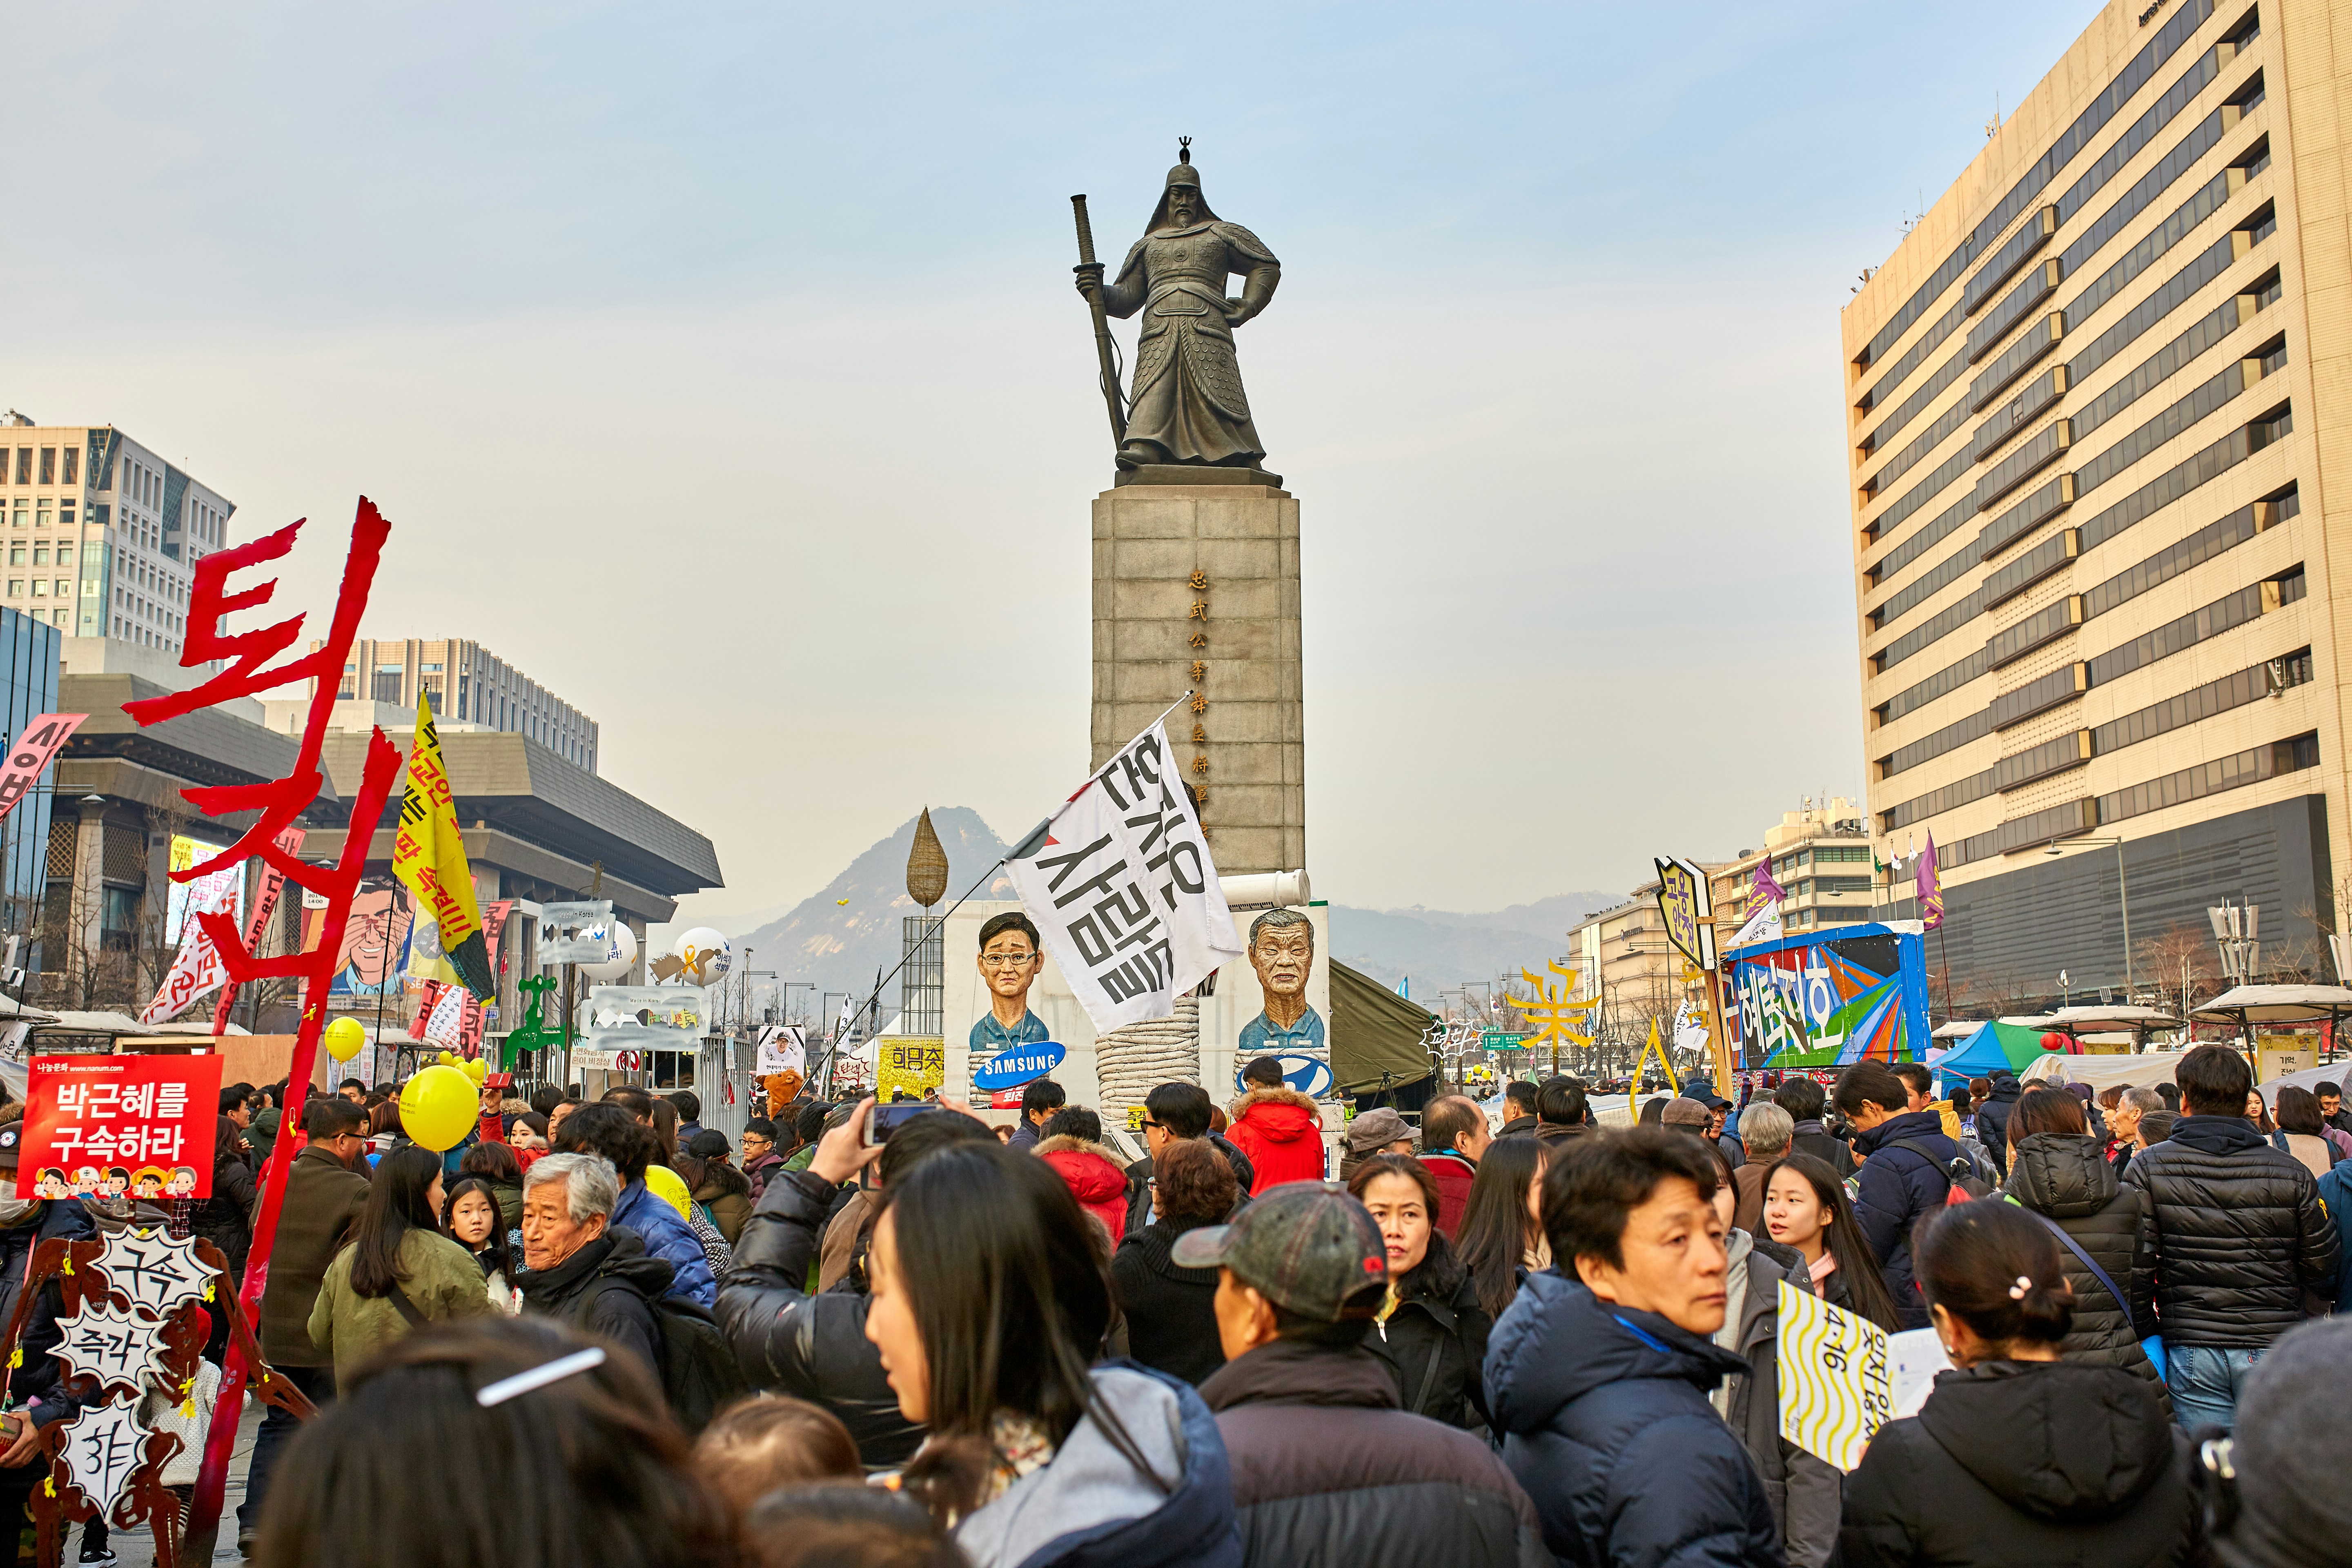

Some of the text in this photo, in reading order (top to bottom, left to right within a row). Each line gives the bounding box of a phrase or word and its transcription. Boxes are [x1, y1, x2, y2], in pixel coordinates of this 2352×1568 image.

[1667, 871, 1689, 914] 고용
[1035, 833, 1174, 1005] 사람들
[1673, 903, 1694, 954] 안정
[893, 1047, 944, 1071] 희망촛
[1430, 1027, 1474, 1056] 평화
[37, 1063, 69, 1072] 나눔문화
[588, 1058, 610, 1066] 비정상
[985, 1054, 1056, 1075] SAMSUNG
[57, 1082, 189, 1119] 박근혜를
[50, 1125, 185, 1163] 구속하라
[113, 1245, 190, 1305] 구속
[71, 1328, 143, 1372] 즉각
